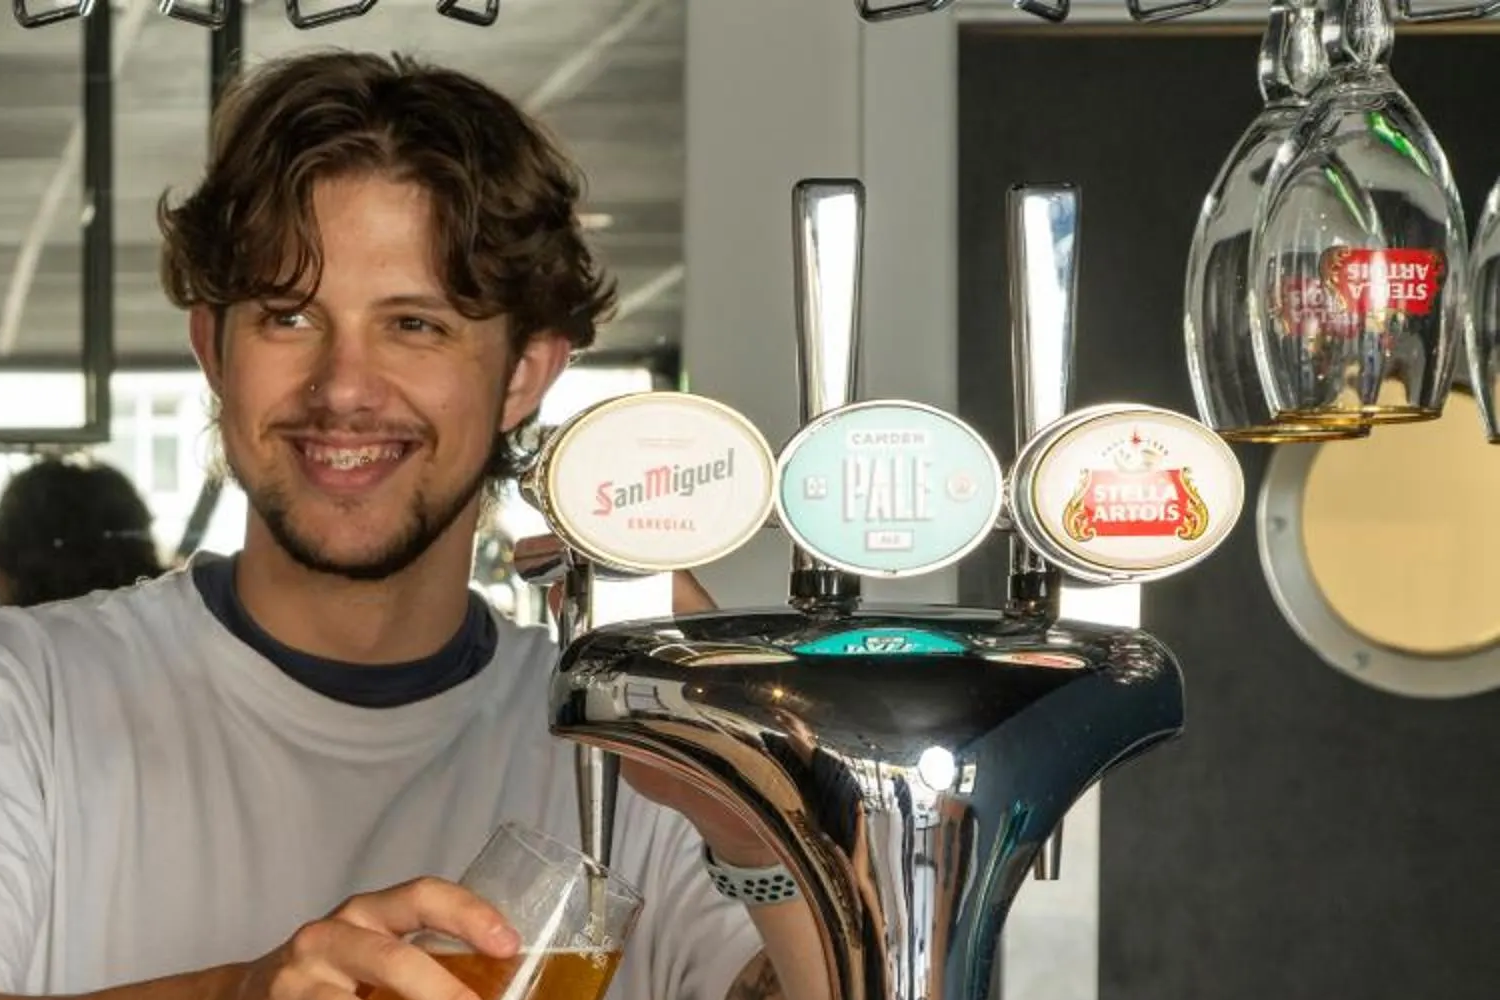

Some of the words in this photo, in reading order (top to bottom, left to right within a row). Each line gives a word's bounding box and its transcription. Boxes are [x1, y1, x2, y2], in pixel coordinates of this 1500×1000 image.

[851, 431, 925, 446] CAMDEN
[841, 454, 934, 523] PALE
[1093, 482, 1179, 501] STELLA
[1091, 503, 1181, 522] ARTOIS
[627, 516, 698, 532] ESPECIAL
